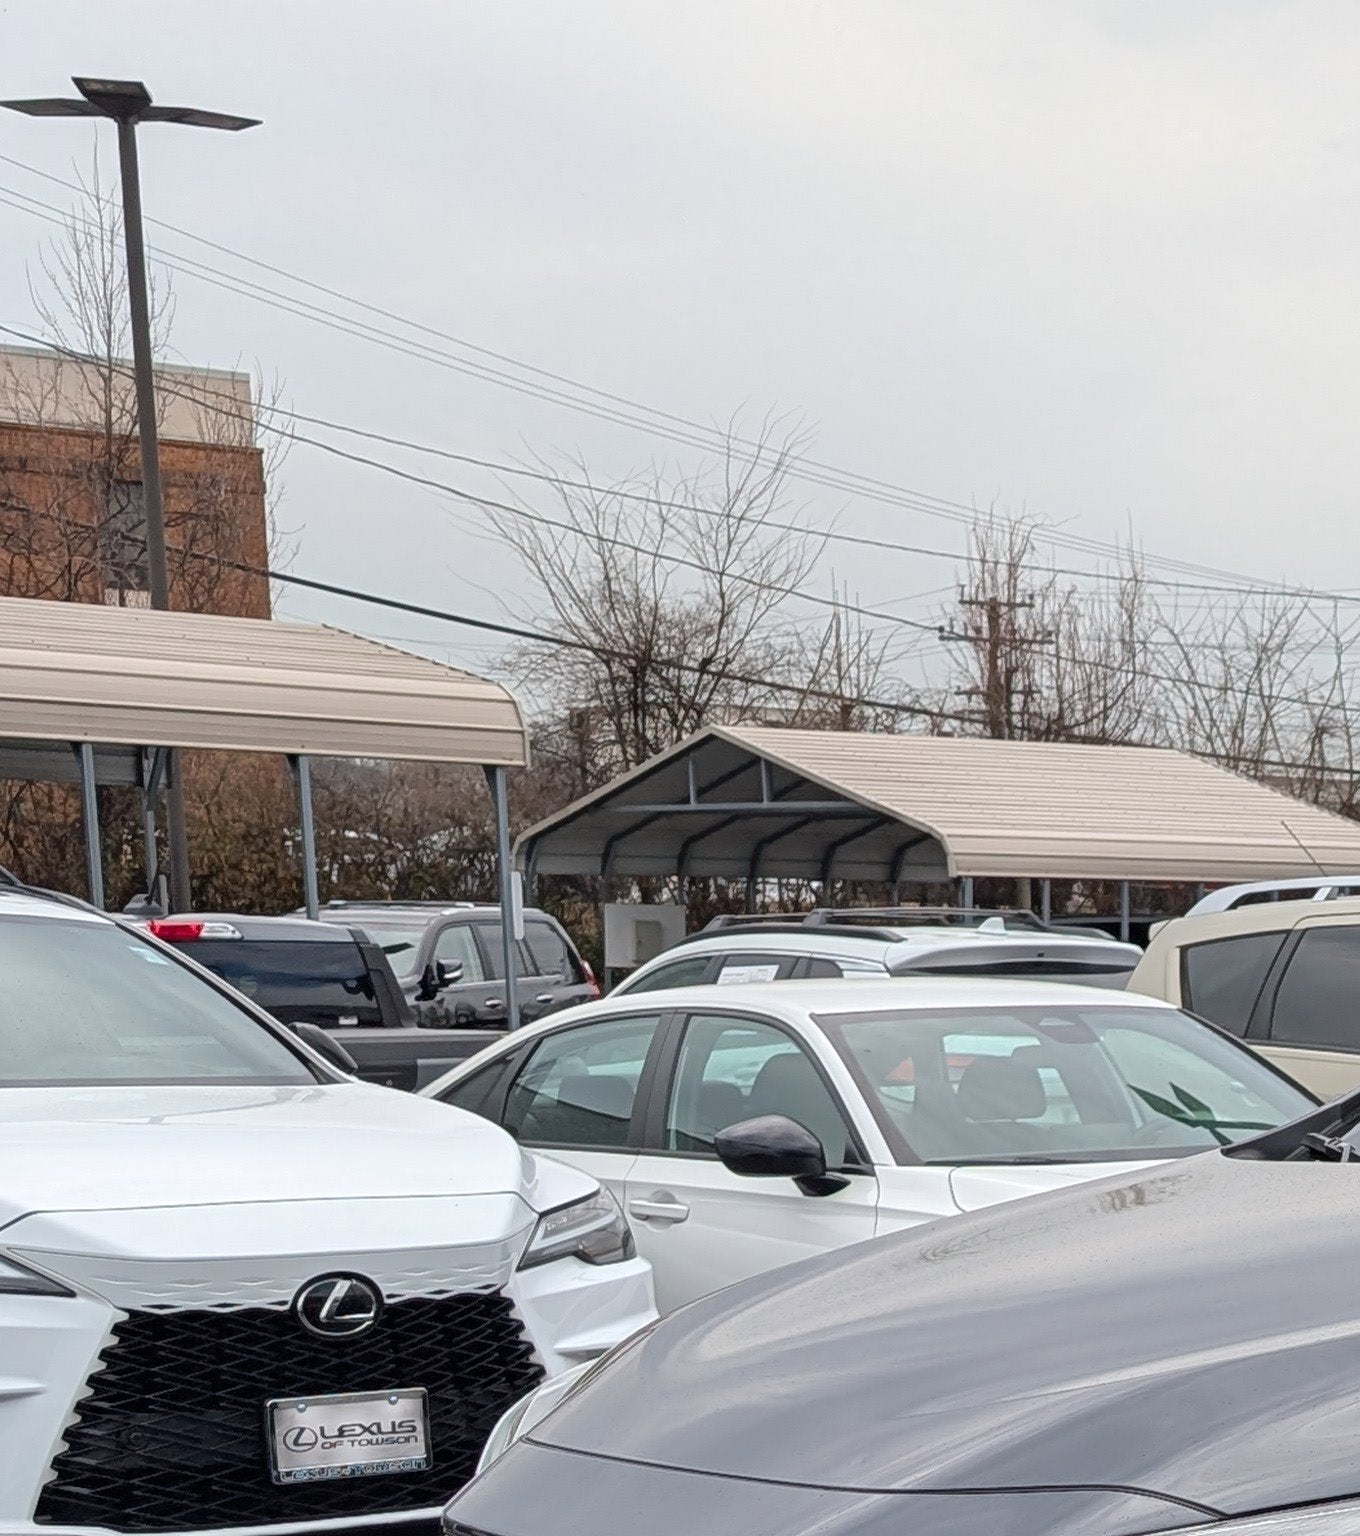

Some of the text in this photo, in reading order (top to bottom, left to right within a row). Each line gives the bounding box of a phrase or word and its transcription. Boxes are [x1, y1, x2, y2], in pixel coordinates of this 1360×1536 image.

[319, 1419, 417, 1439] LEXUS
[321, 1434, 418, 1450] OF TOWSON
